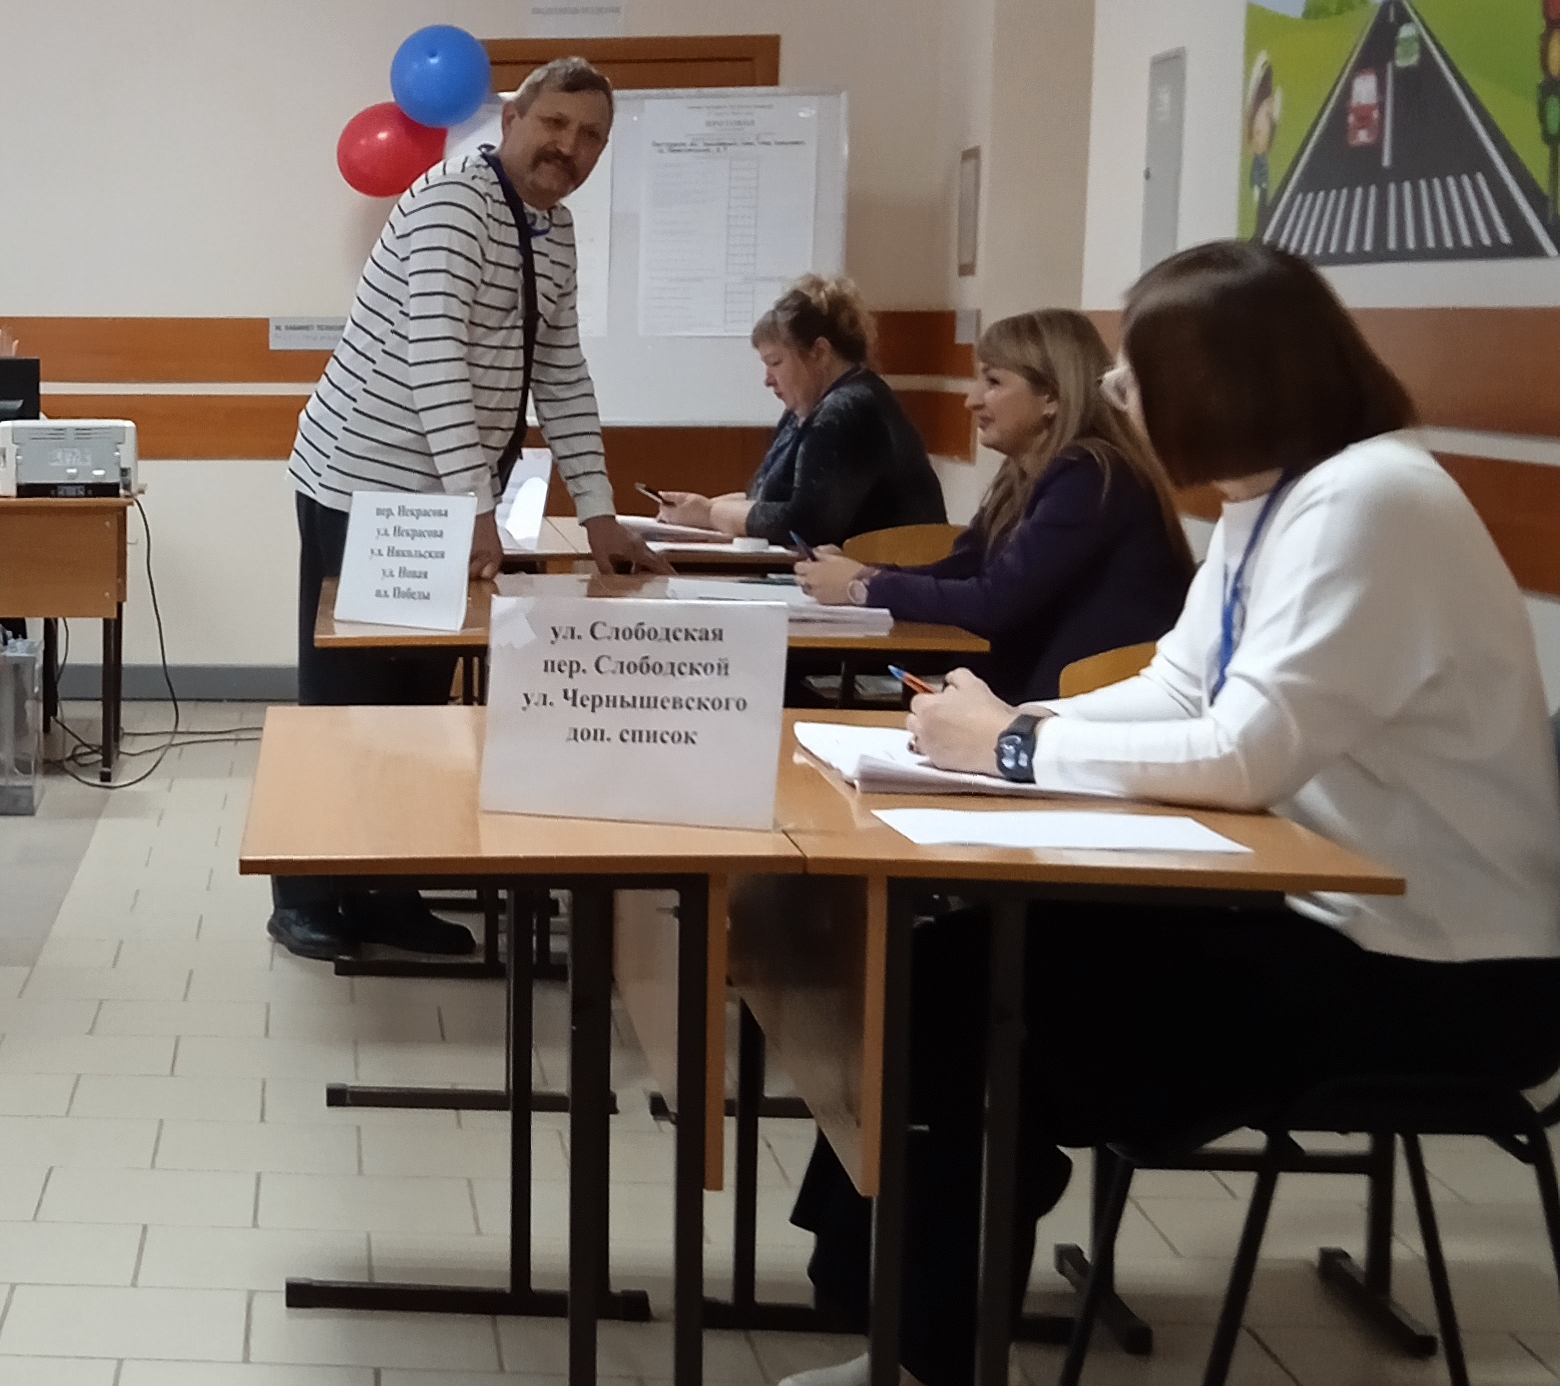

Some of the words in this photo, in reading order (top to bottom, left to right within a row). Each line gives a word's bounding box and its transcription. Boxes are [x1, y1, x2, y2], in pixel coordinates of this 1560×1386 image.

[397, 505, 449, 520] Некрасова
[392, 525, 444, 540] Некрасова
[549, 624, 582, 644] ул.
[589, 621, 724, 643] Слободская
[543, 657, 587, 679] пер.
[594, 655, 730, 677] Слободской
[521, 691, 554, 711] ул.
[562, 688, 748, 713] Чернышевского
[565, 727, 612, 744] доп.
[619, 729, 699, 746] список
